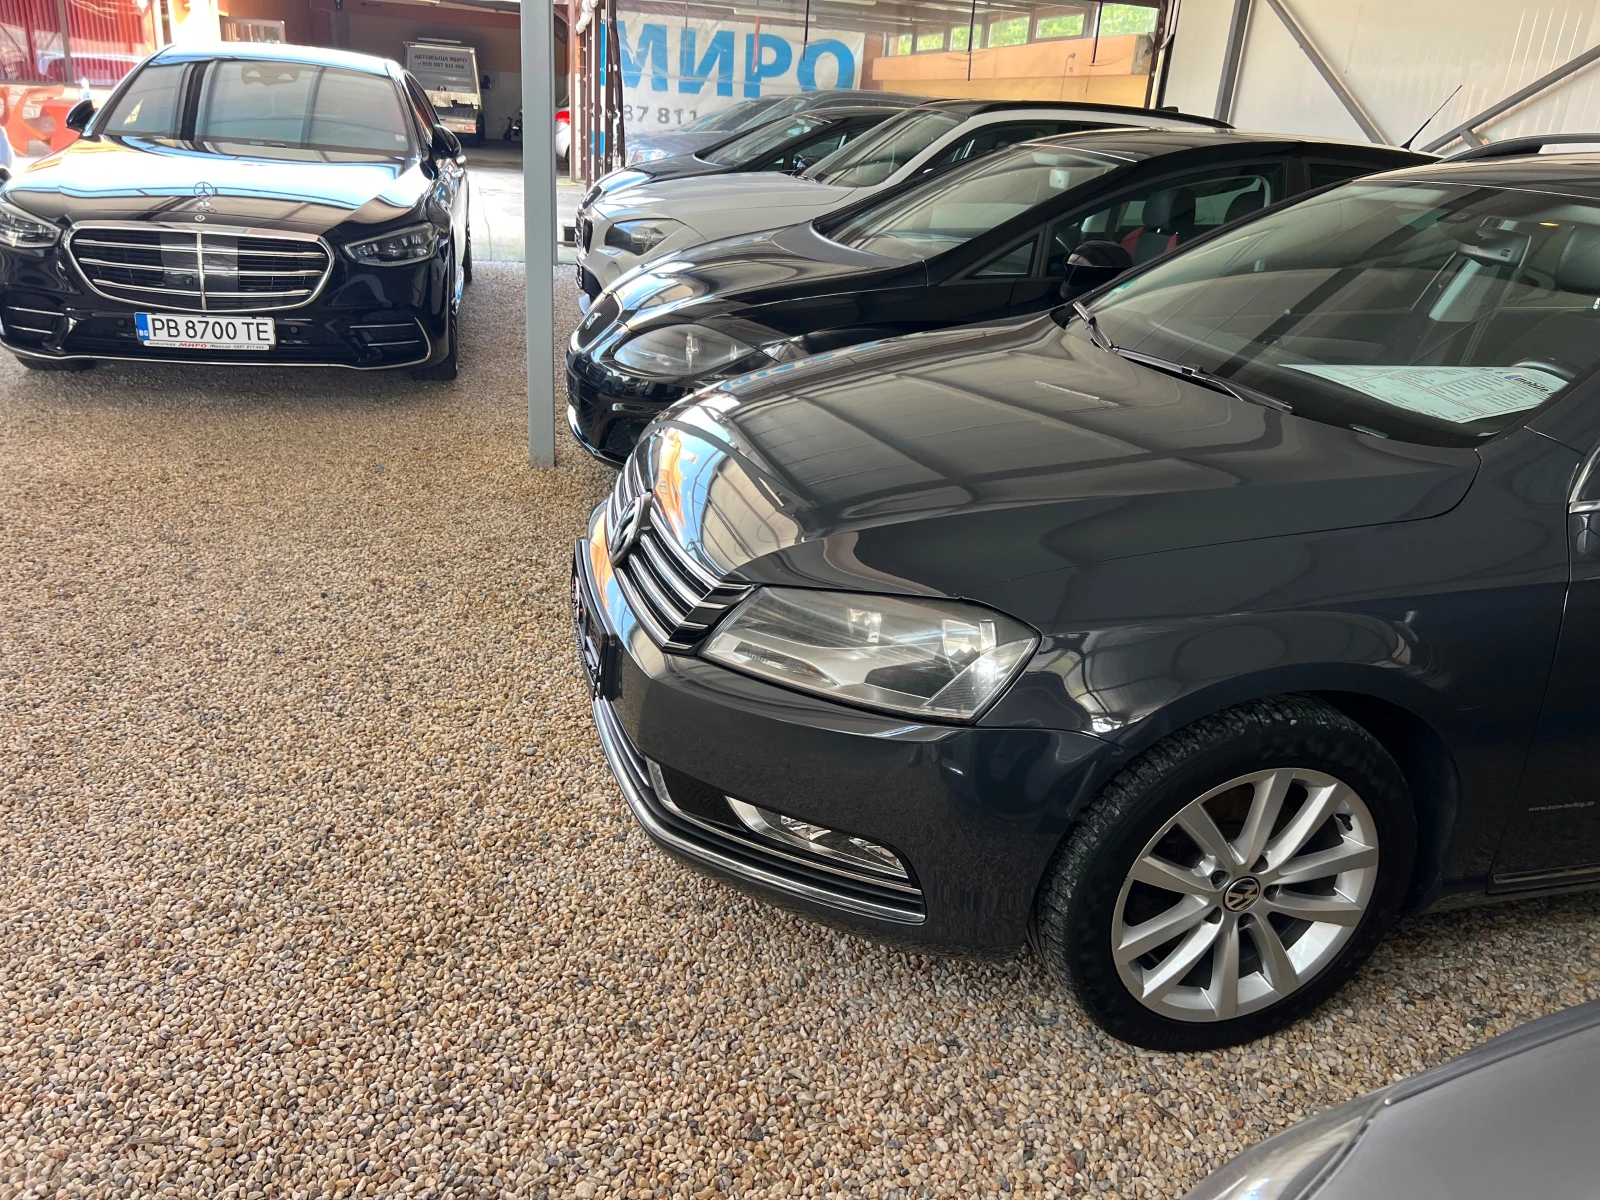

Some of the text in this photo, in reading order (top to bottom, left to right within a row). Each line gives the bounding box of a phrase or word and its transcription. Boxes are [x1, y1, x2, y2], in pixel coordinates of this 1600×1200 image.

[601, 20, 856, 99] МИРО
[151, 317, 270, 341] PB 8700 TE
